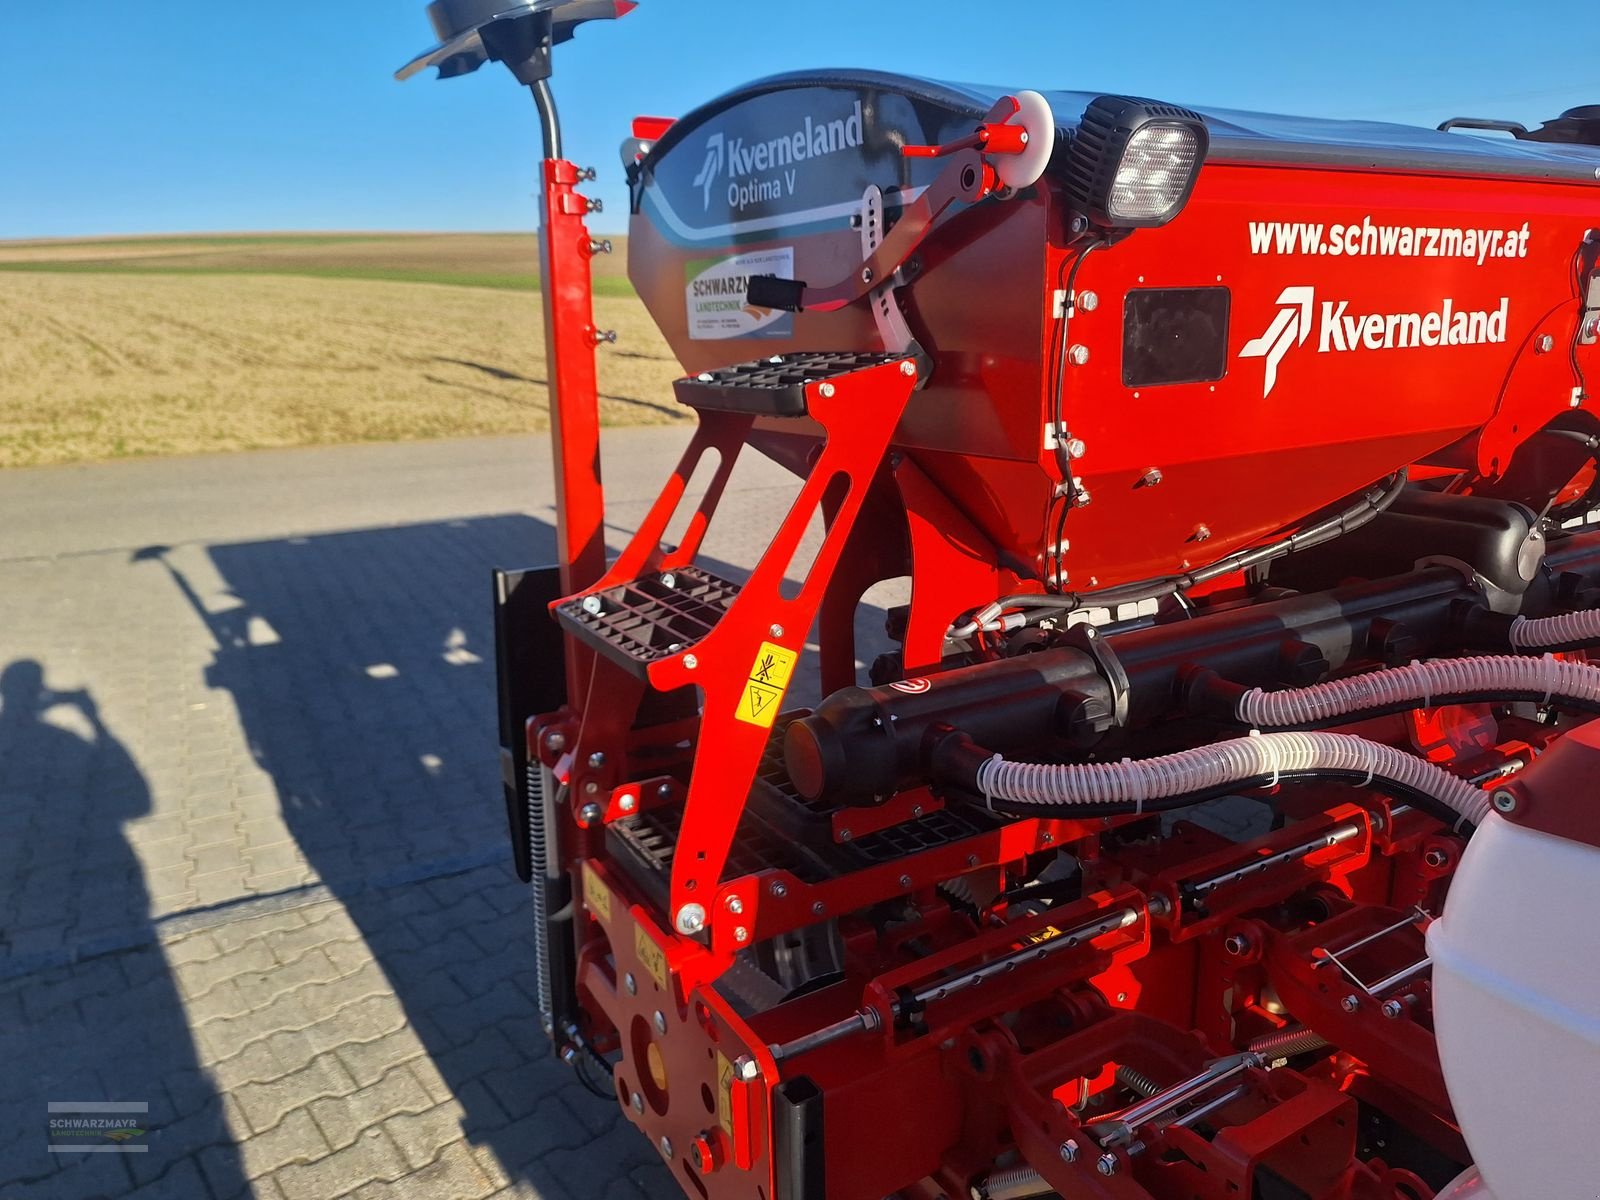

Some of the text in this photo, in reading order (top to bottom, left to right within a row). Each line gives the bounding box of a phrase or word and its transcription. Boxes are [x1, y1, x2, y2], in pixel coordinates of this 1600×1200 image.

[728, 100, 864, 178] Kverneland
[728, 168, 797, 211] Optima V
[1249, 215, 1530, 266] www.schwarzmayr.at
[693, 273, 776, 297] SCHWARZM
[1317, 297, 1510, 352] Kverneland
